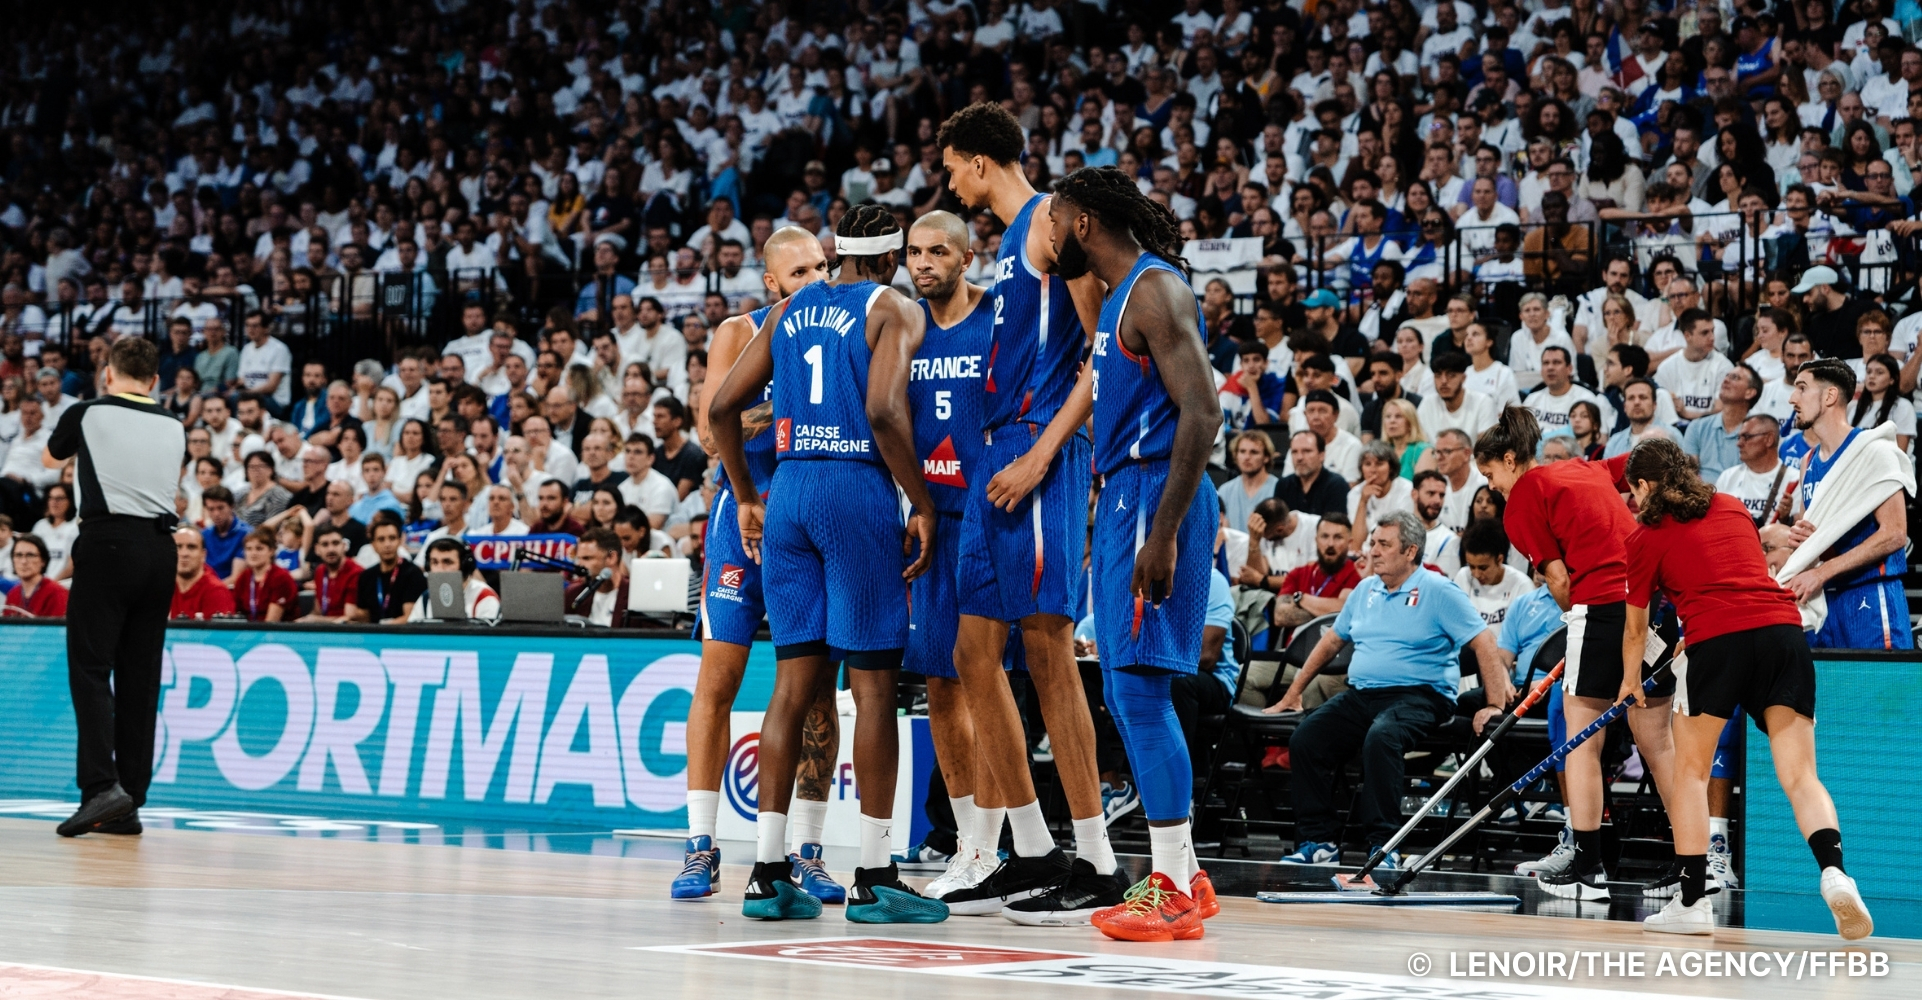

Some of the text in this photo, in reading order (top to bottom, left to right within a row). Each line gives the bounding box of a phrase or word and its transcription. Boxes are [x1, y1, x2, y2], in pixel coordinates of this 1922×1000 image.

[994, 256, 1015, 286] ANCE
[994, 295, 1004, 325] 2
[1093, 331, 1110, 356] ANCE
[803, 345, 822, 404] 1
[910, 355, 982, 381] FRANCE
[935, 390, 951, 420] 5
[795, 424, 840, 439] CAISSE
[794, 438, 870, 453] D'EPARGNE
[924, 459, 961, 476] MAIF
[717, 586, 739, 596] CAISSE
[152, 643, 703, 812] PORTMAG
